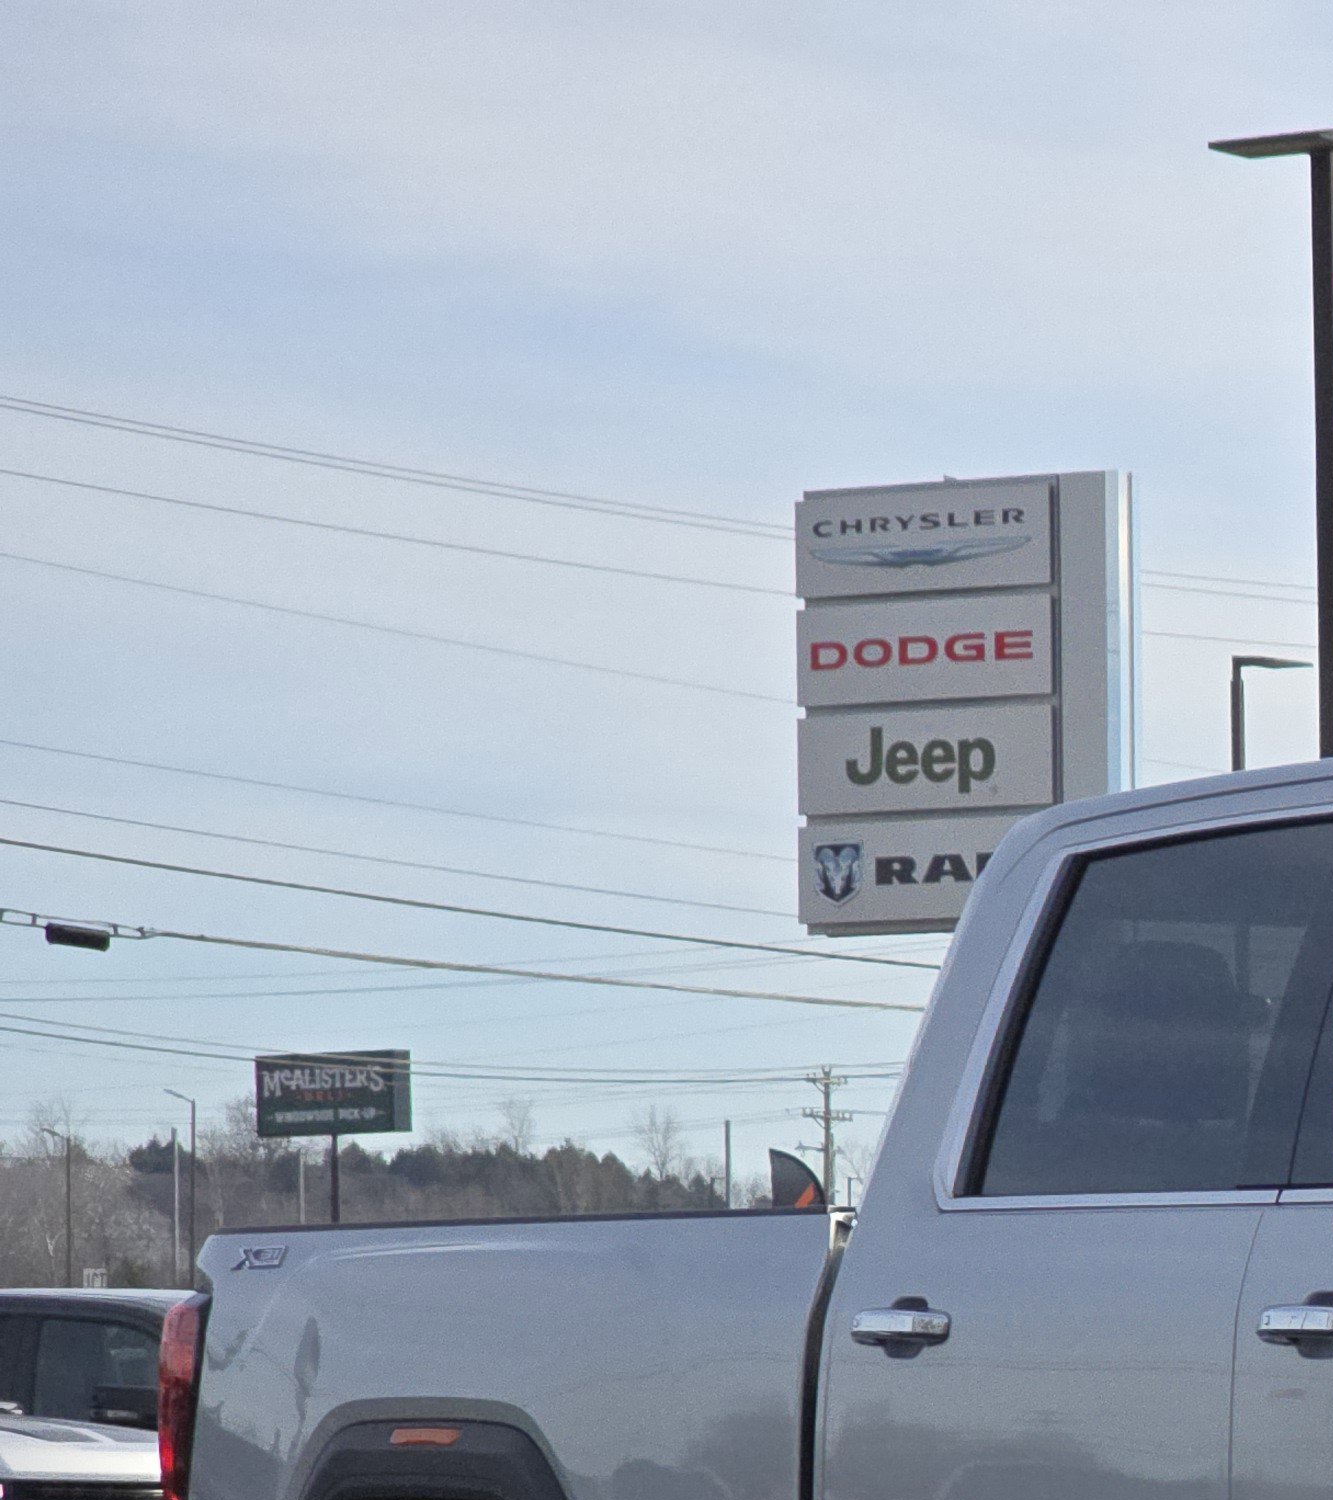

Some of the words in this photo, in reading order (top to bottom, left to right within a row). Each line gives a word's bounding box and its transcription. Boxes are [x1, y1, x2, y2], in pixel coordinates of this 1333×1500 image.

[812, 507, 1026, 538] CHRYSLER
[810, 629, 1034, 671] DODGE
[845, 726, 996, 794] Jeep
